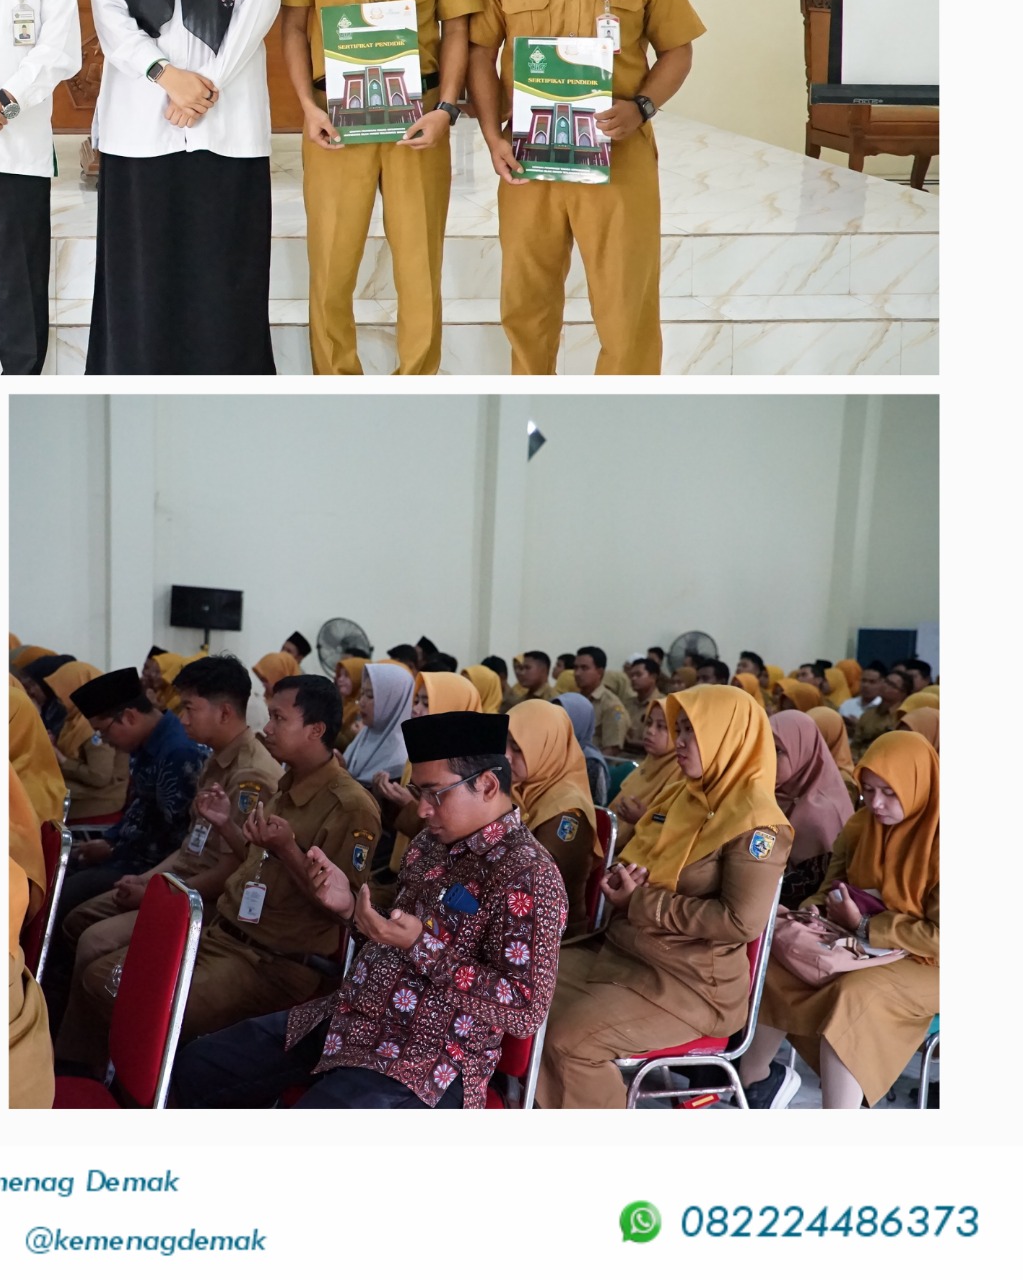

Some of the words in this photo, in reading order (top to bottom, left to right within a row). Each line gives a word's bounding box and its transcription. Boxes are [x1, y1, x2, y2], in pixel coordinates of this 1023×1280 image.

[337, 42, 374, 51] SERTIFIKAT
[375, 40, 406, 48] PENDIDIK
[527, 77, 566, 85] SERTIFIKAT
